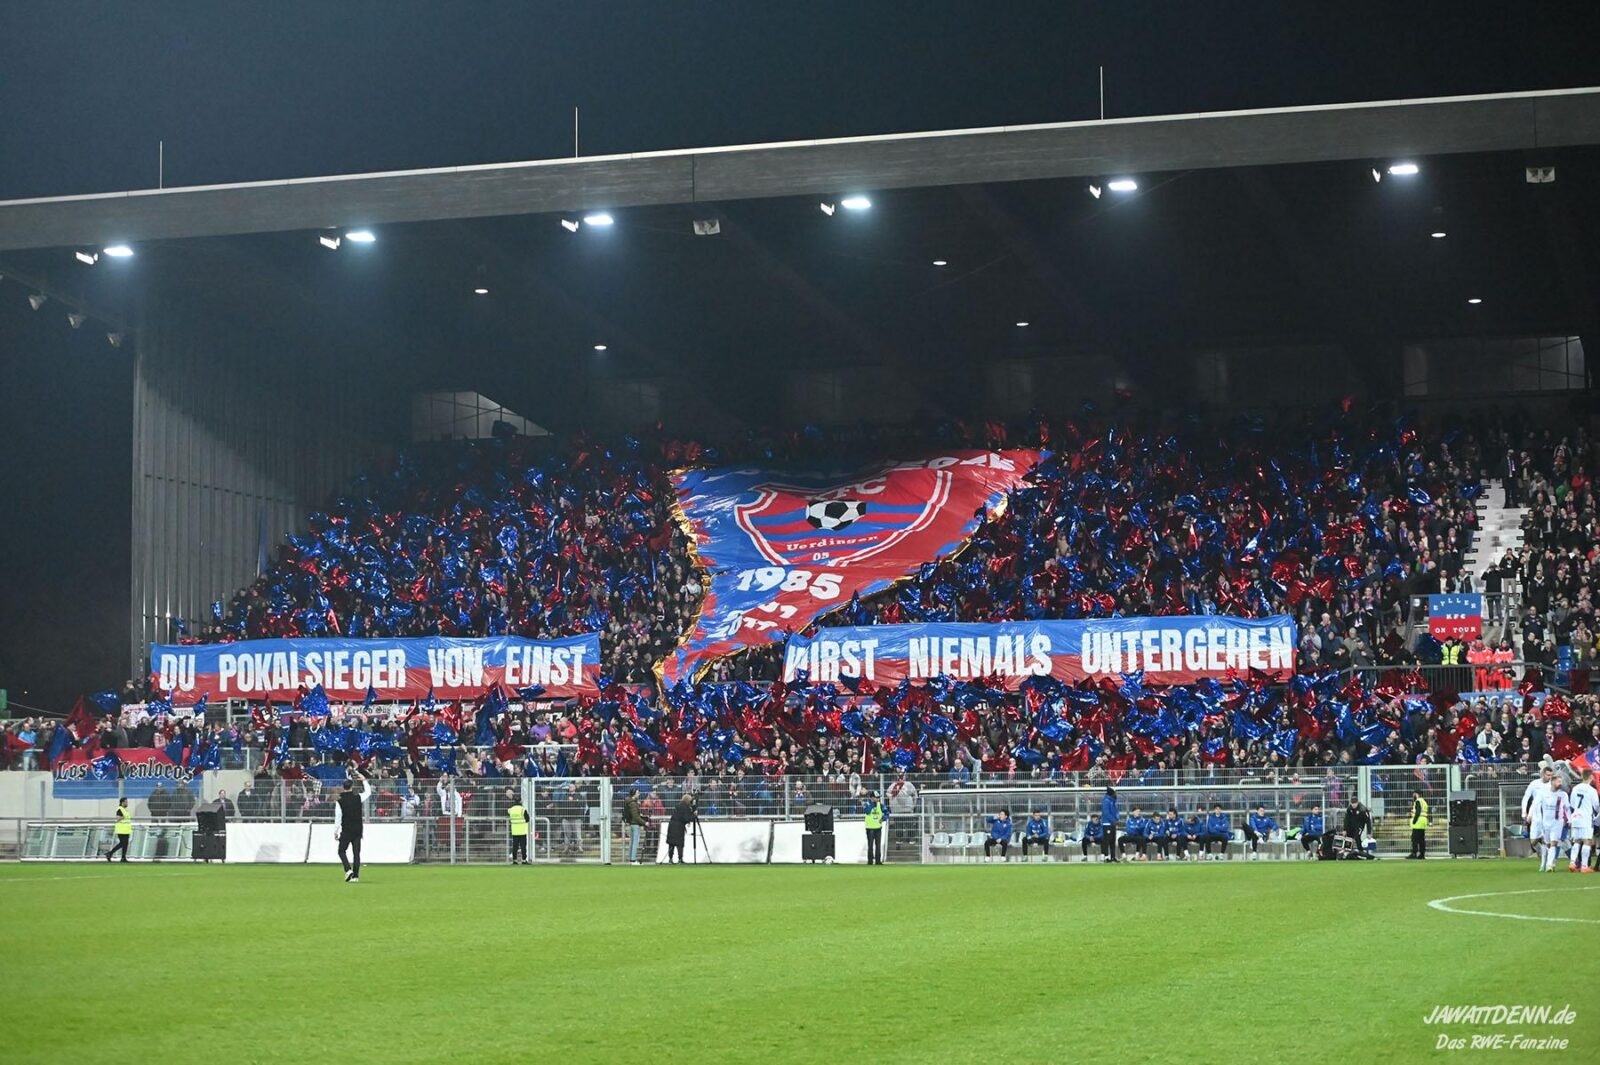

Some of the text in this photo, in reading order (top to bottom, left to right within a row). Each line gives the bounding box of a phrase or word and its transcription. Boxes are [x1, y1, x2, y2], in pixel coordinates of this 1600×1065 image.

[812, 551, 830, 561] 05
[736, 566, 845, 600] 1985
[159, 644, 588, 693] DU POKALSIEGER VON EINST
[784, 626, 1293, 683] WIRST NIEMALS UNTERGEHEN
[55, 756, 195, 783] Los Venlocos
[1577, 793, 1584, 809] 7
